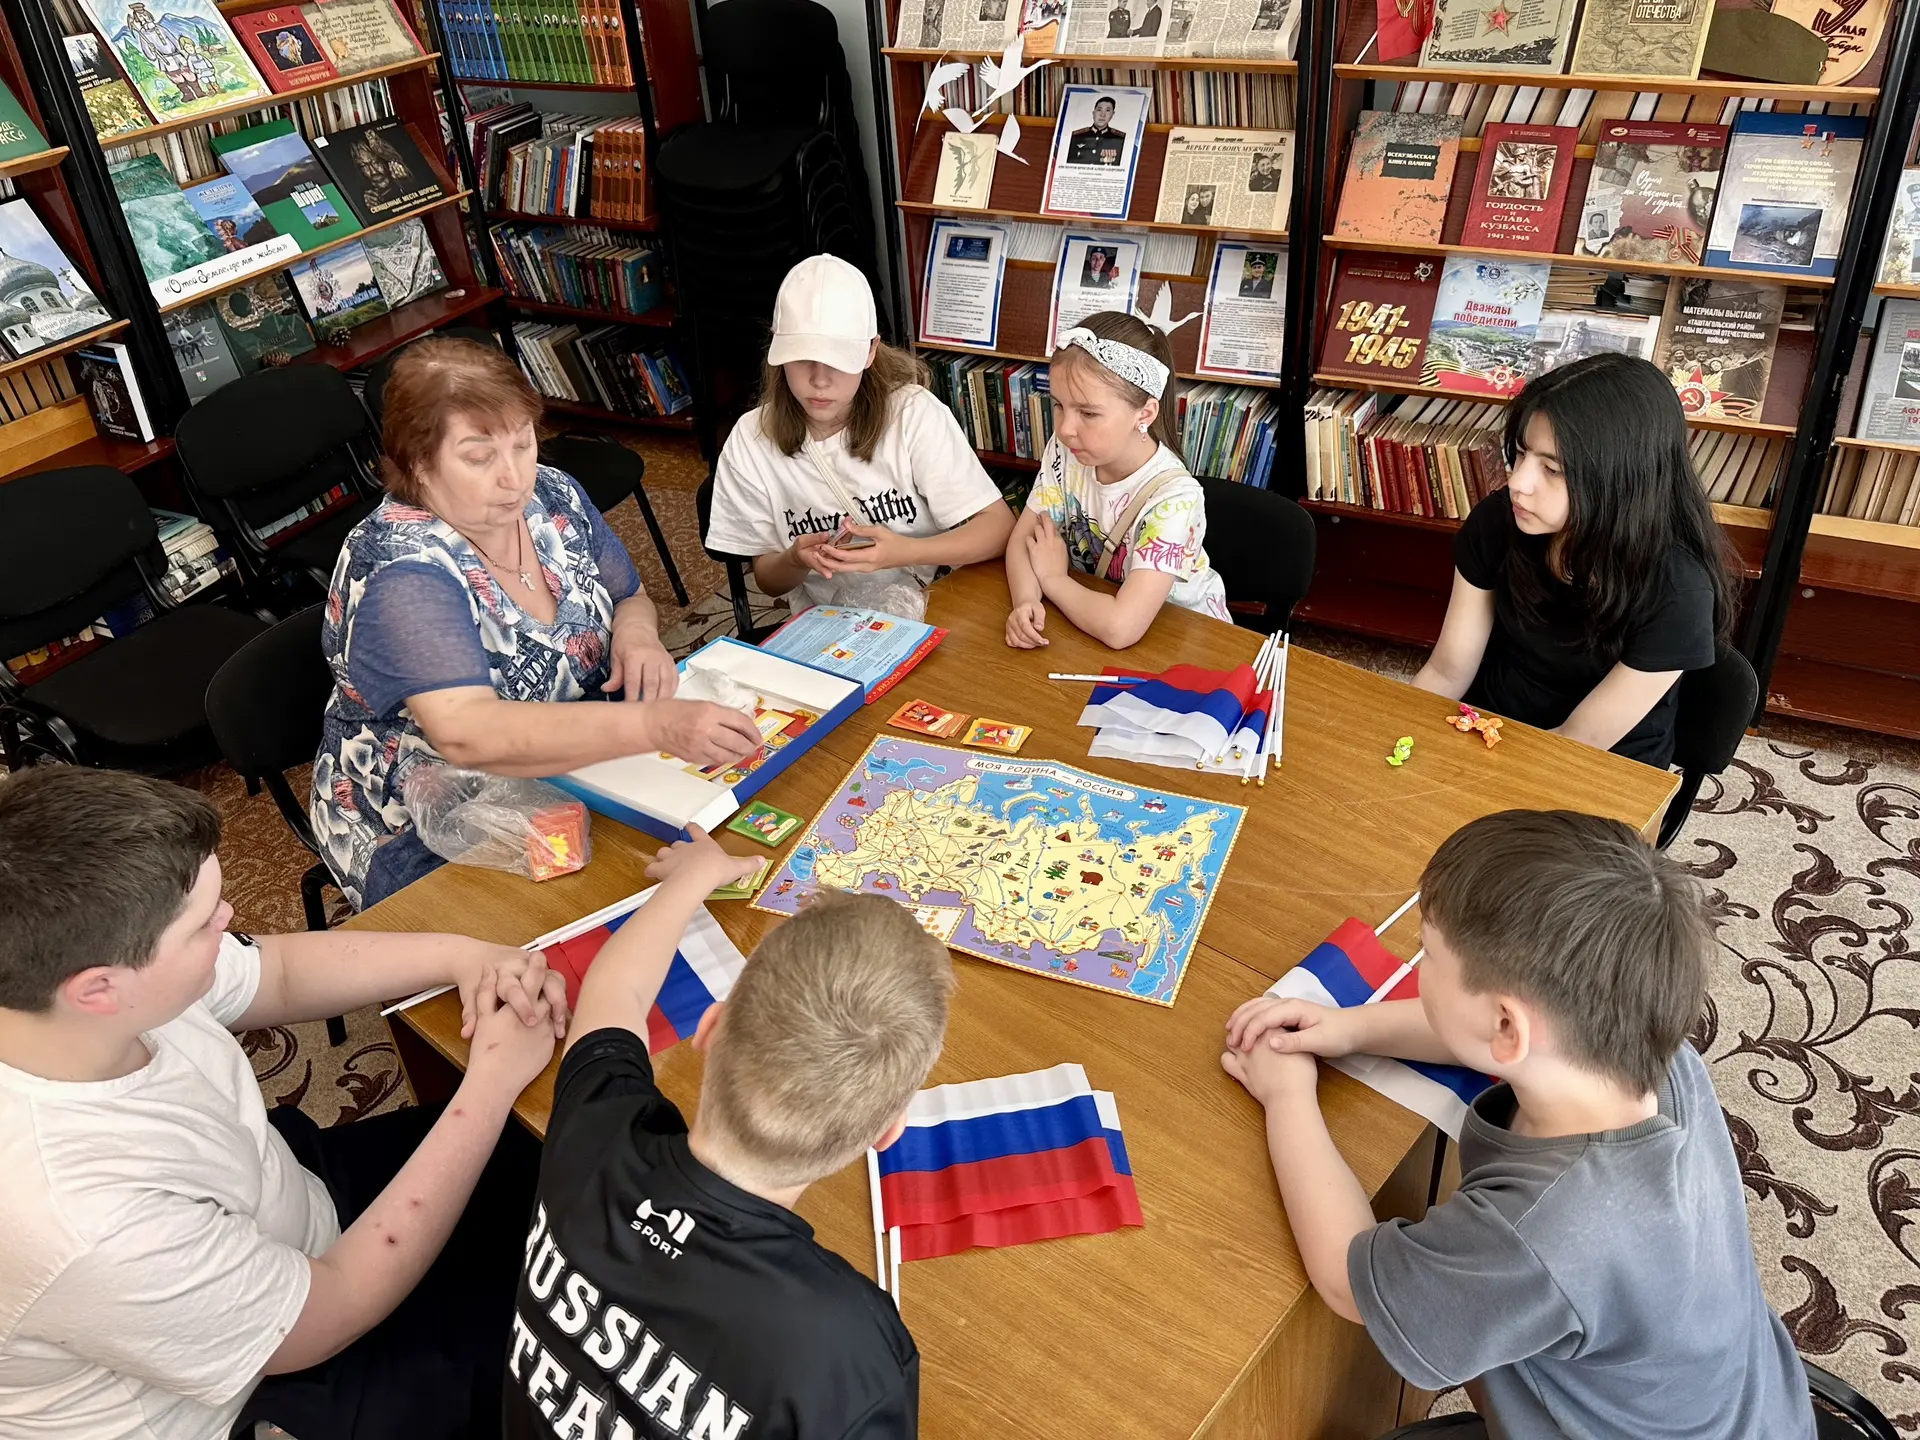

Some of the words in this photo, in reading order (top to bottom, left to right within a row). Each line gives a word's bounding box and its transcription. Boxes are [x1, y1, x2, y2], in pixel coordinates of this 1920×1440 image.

[1636, 5, 1682, 19] ОТЕЧЕСТВА
[1840, 25, 1867, 36] МАЯ
[0, 129, 27, 145] АССА
[1387, 152, 1436, 160] ВСЕКУЗБАССКАЯ
[1773, 158, 1808, 166] СОВЕТСКОГО
[1485, 201, 1544, 212] ГОРДОСТЬ
[1492, 214, 1531, 223] СЛАВА
[1480, 221, 1540, 233] КУЗБАССА
[1464, 300, 1511, 315] Дважды
[1683, 306, 1724, 317] МАТЕРИАЛЫ
[1725, 309, 1762, 320] ВЫСТАВКИ
[1335, 300, 1410, 335] 1941-
[1453, 312, 1517, 328] победители
[1687, 319, 1737, 329] «ТАШТАГОЛЬСКИЙ
[1736, 322, 1755, 331] РАЙОН
[1695, 327, 1720, 336] ВЕЛИКОЙ
[1720, 330, 1765, 340] ОТЕЧЕСТВЕННОЙ
[1706, 336, 1729, 345] ВОЙНЫ»
[1344, 333, 1422, 369] 1945
[1902, 407, 1920, 415] АФГ
[974, 761, 1002, 770] МОЯ
[1007, 766, 1057, 777] РОДИНА
[1075, 778, 1124, 797] РОССИЯ
[630, 1219, 683, 1261] SPORT
[525, 1199, 753, 1440] RUSSIAN
